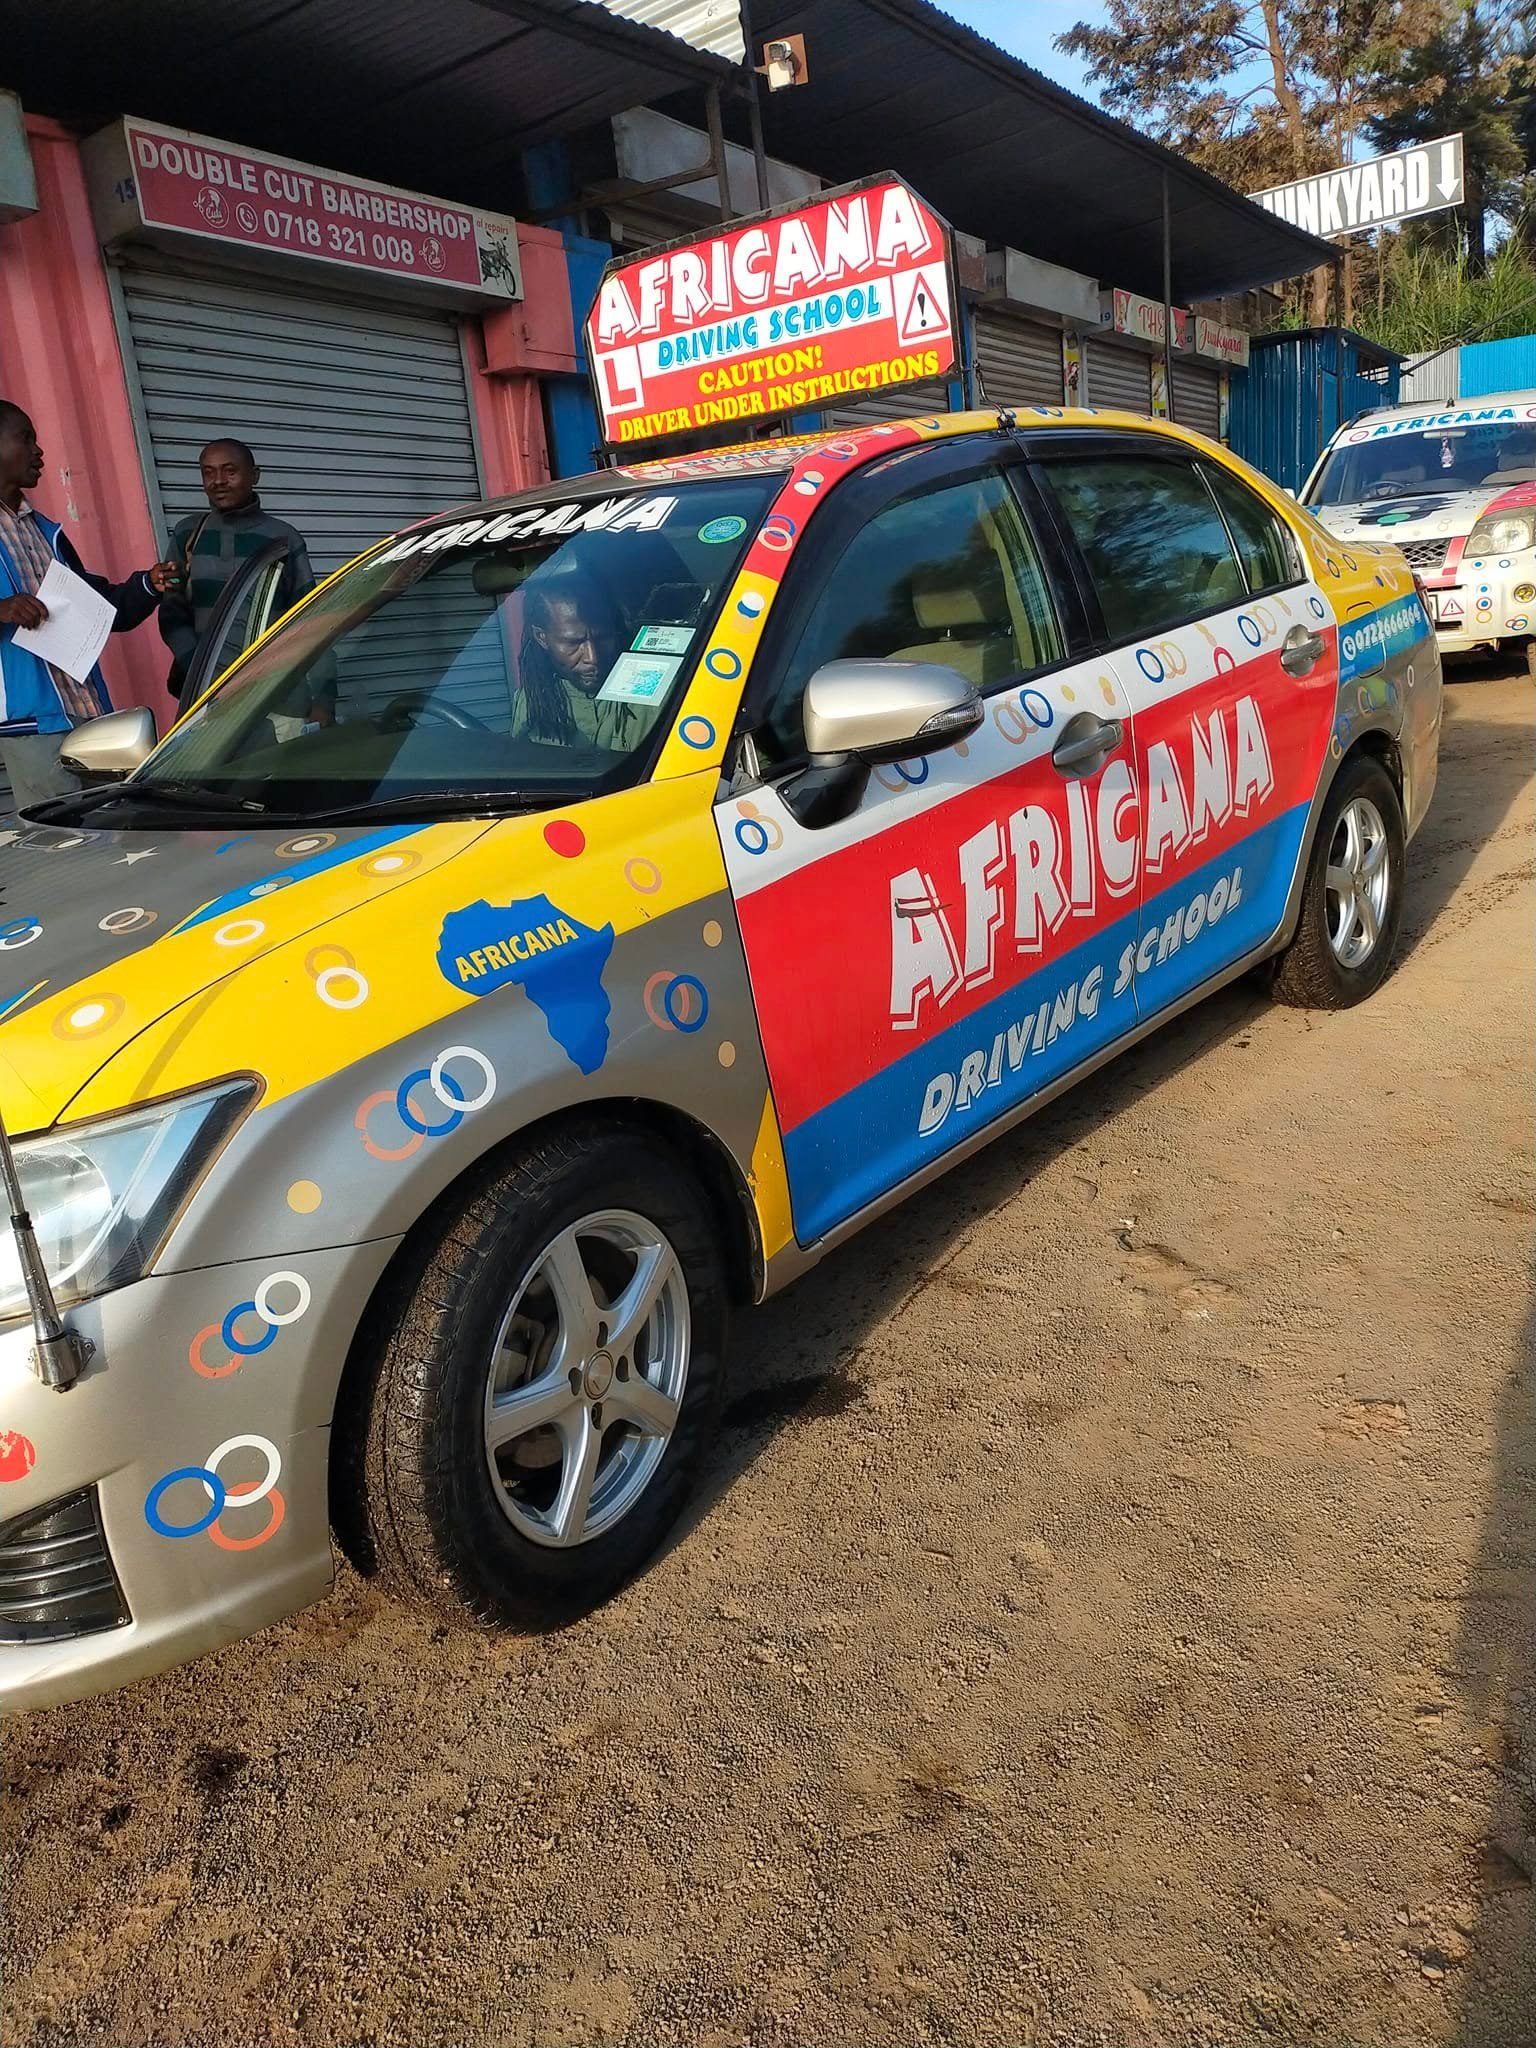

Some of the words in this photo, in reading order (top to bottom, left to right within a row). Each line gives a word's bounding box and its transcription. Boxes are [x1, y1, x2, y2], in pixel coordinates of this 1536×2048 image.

[135, 136, 259, 194] DOUBLE
[263, 169, 315, 207] CUT
[320, 183, 471, 241] BARBERSHOP
[263, 208, 322, 247] 0718
[327, 223, 367, 257] 321
[372, 233, 415, 265] 008
[597, 184, 932, 344] AFRICANA
[657, 315, 758, 369] DRIVING
[769, 284, 882, 342] SCHOOL
[608, 355, 637, 402] L
[619, 407, 693, 443] DRIVER
[694, 391, 765, 426] UNDER
[769, 350, 940, 410] INSTRUCTIONS
[697, 345, 824, 395] CAUTION!
[1372, 408, 1516, 437] AFRICANA
[362, 496, 680, 572] AFRICANA
[888, 695, 1275, 1032] AFRICANA
[454, 916, 581, 983] AFRICANA
[918, 965, 1104, 1138] DRIVING
[1112, 865, 1245, 1000] SCHOOL
